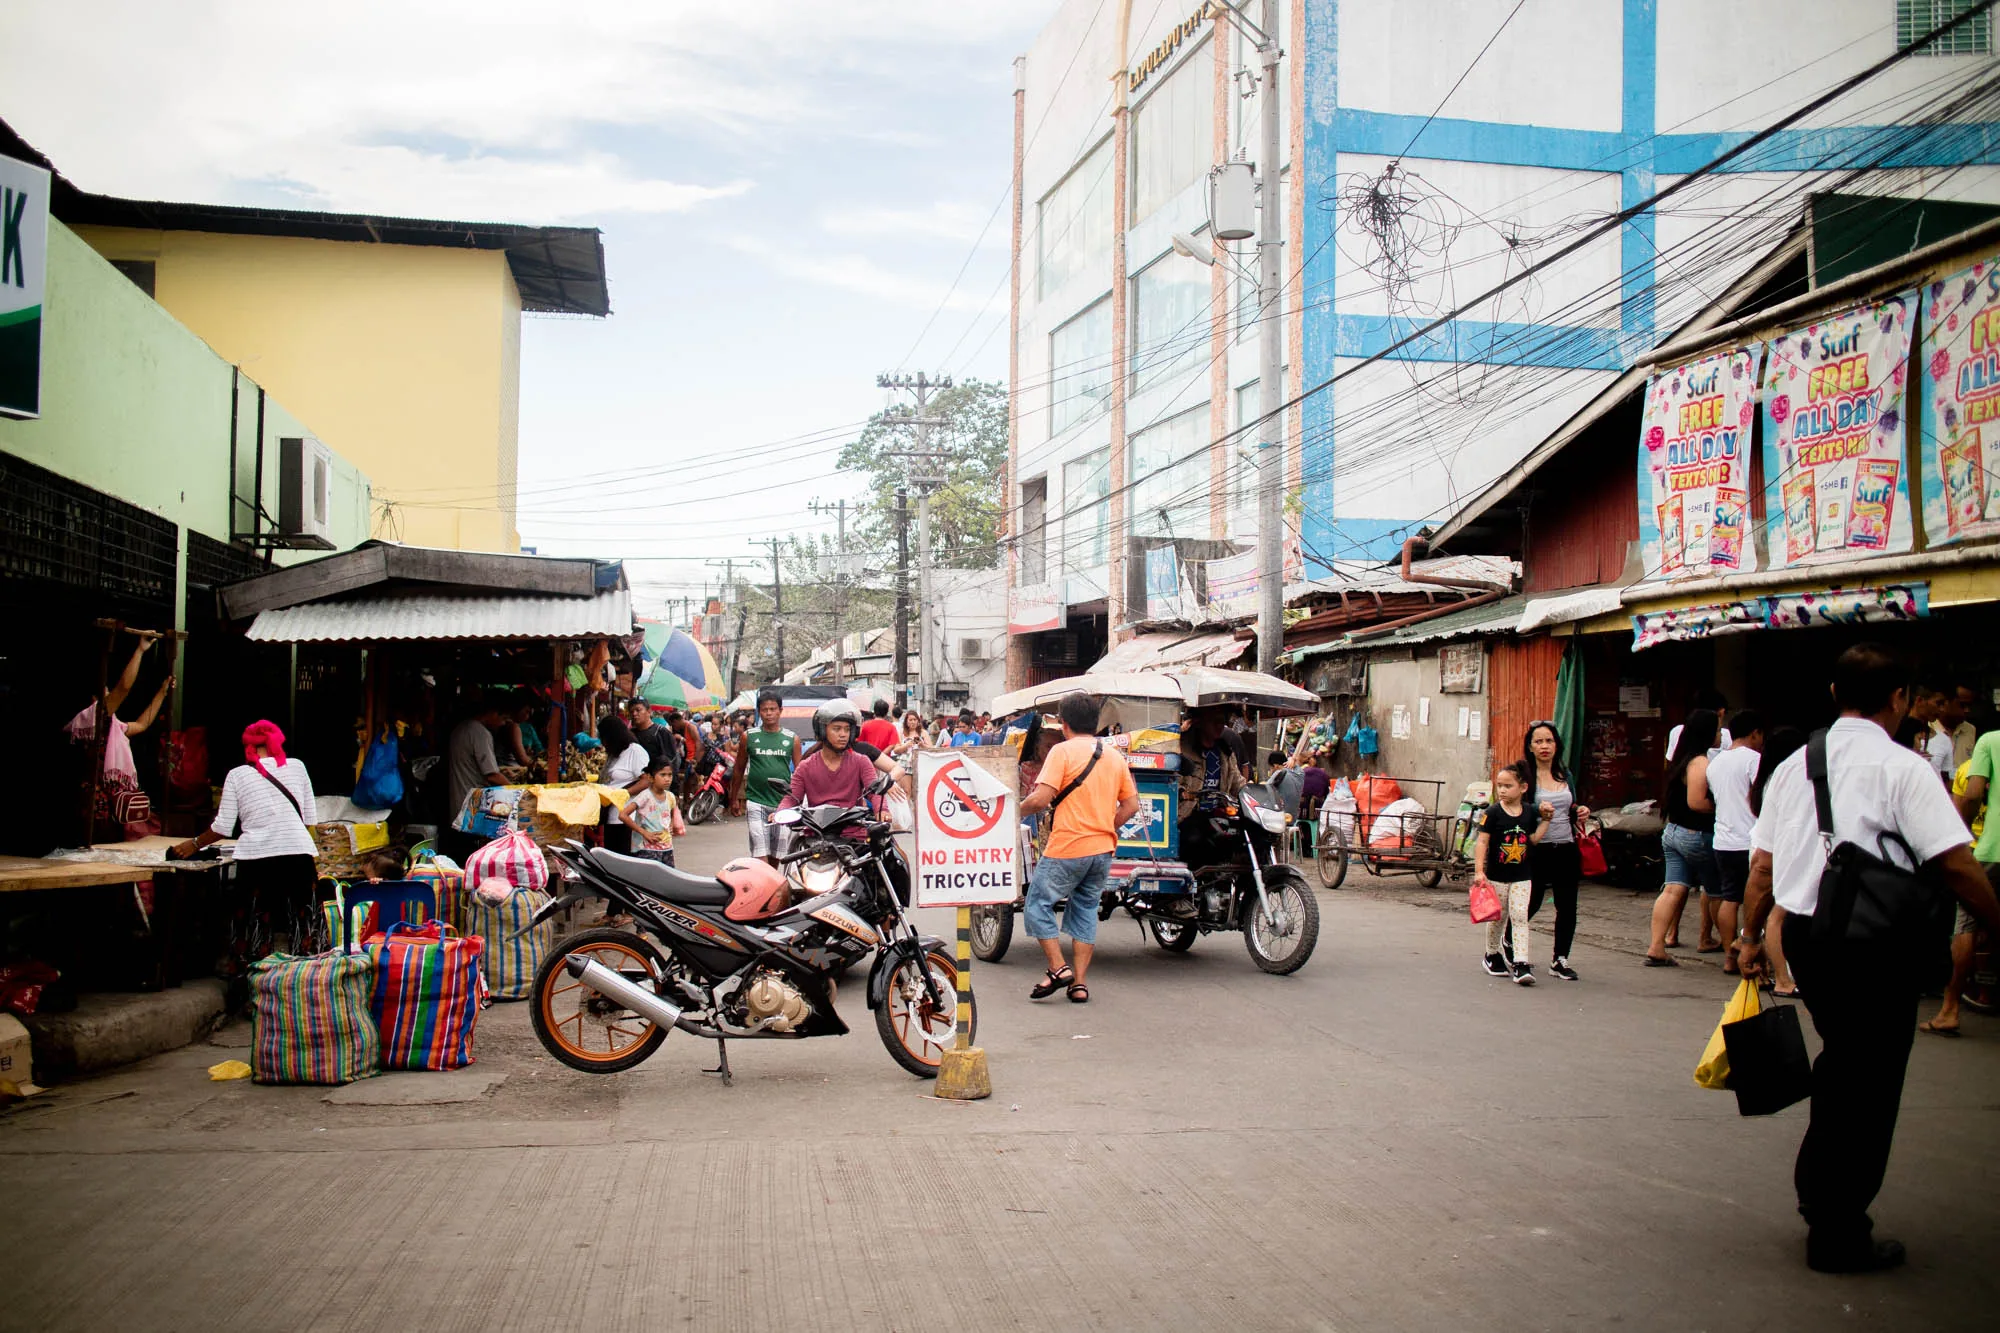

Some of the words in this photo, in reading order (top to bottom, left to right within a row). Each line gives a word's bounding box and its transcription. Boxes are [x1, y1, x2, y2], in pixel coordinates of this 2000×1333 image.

[1820, 323, 1861, 360] Surf
[1687, 367, 1719, 398] Surf
[1809, 354, 1868, 402] FREE
[1679, 395, 1724, 435] FREE
[1792, 403, 1833, 441] ALL
[1835, 388, 1882, 434] DAY
[1666, 437, 1698, 467] ALL
[1799, 438, 1844, 467] TEXTS
[1670, 468, 1707, 491] TEXTS
[1856, 482, 1892, 504] Surf
[1714, 507, 1743, 527] Surf
[922, 850, 946, 866] NO
[954, 848, 1014, 865] ENTRY
[923, 872, 1012, 889] TRICYCLE
[636, 893, 699, 931] RAIDER
[821, 910, 860, 934] SUZUKI
